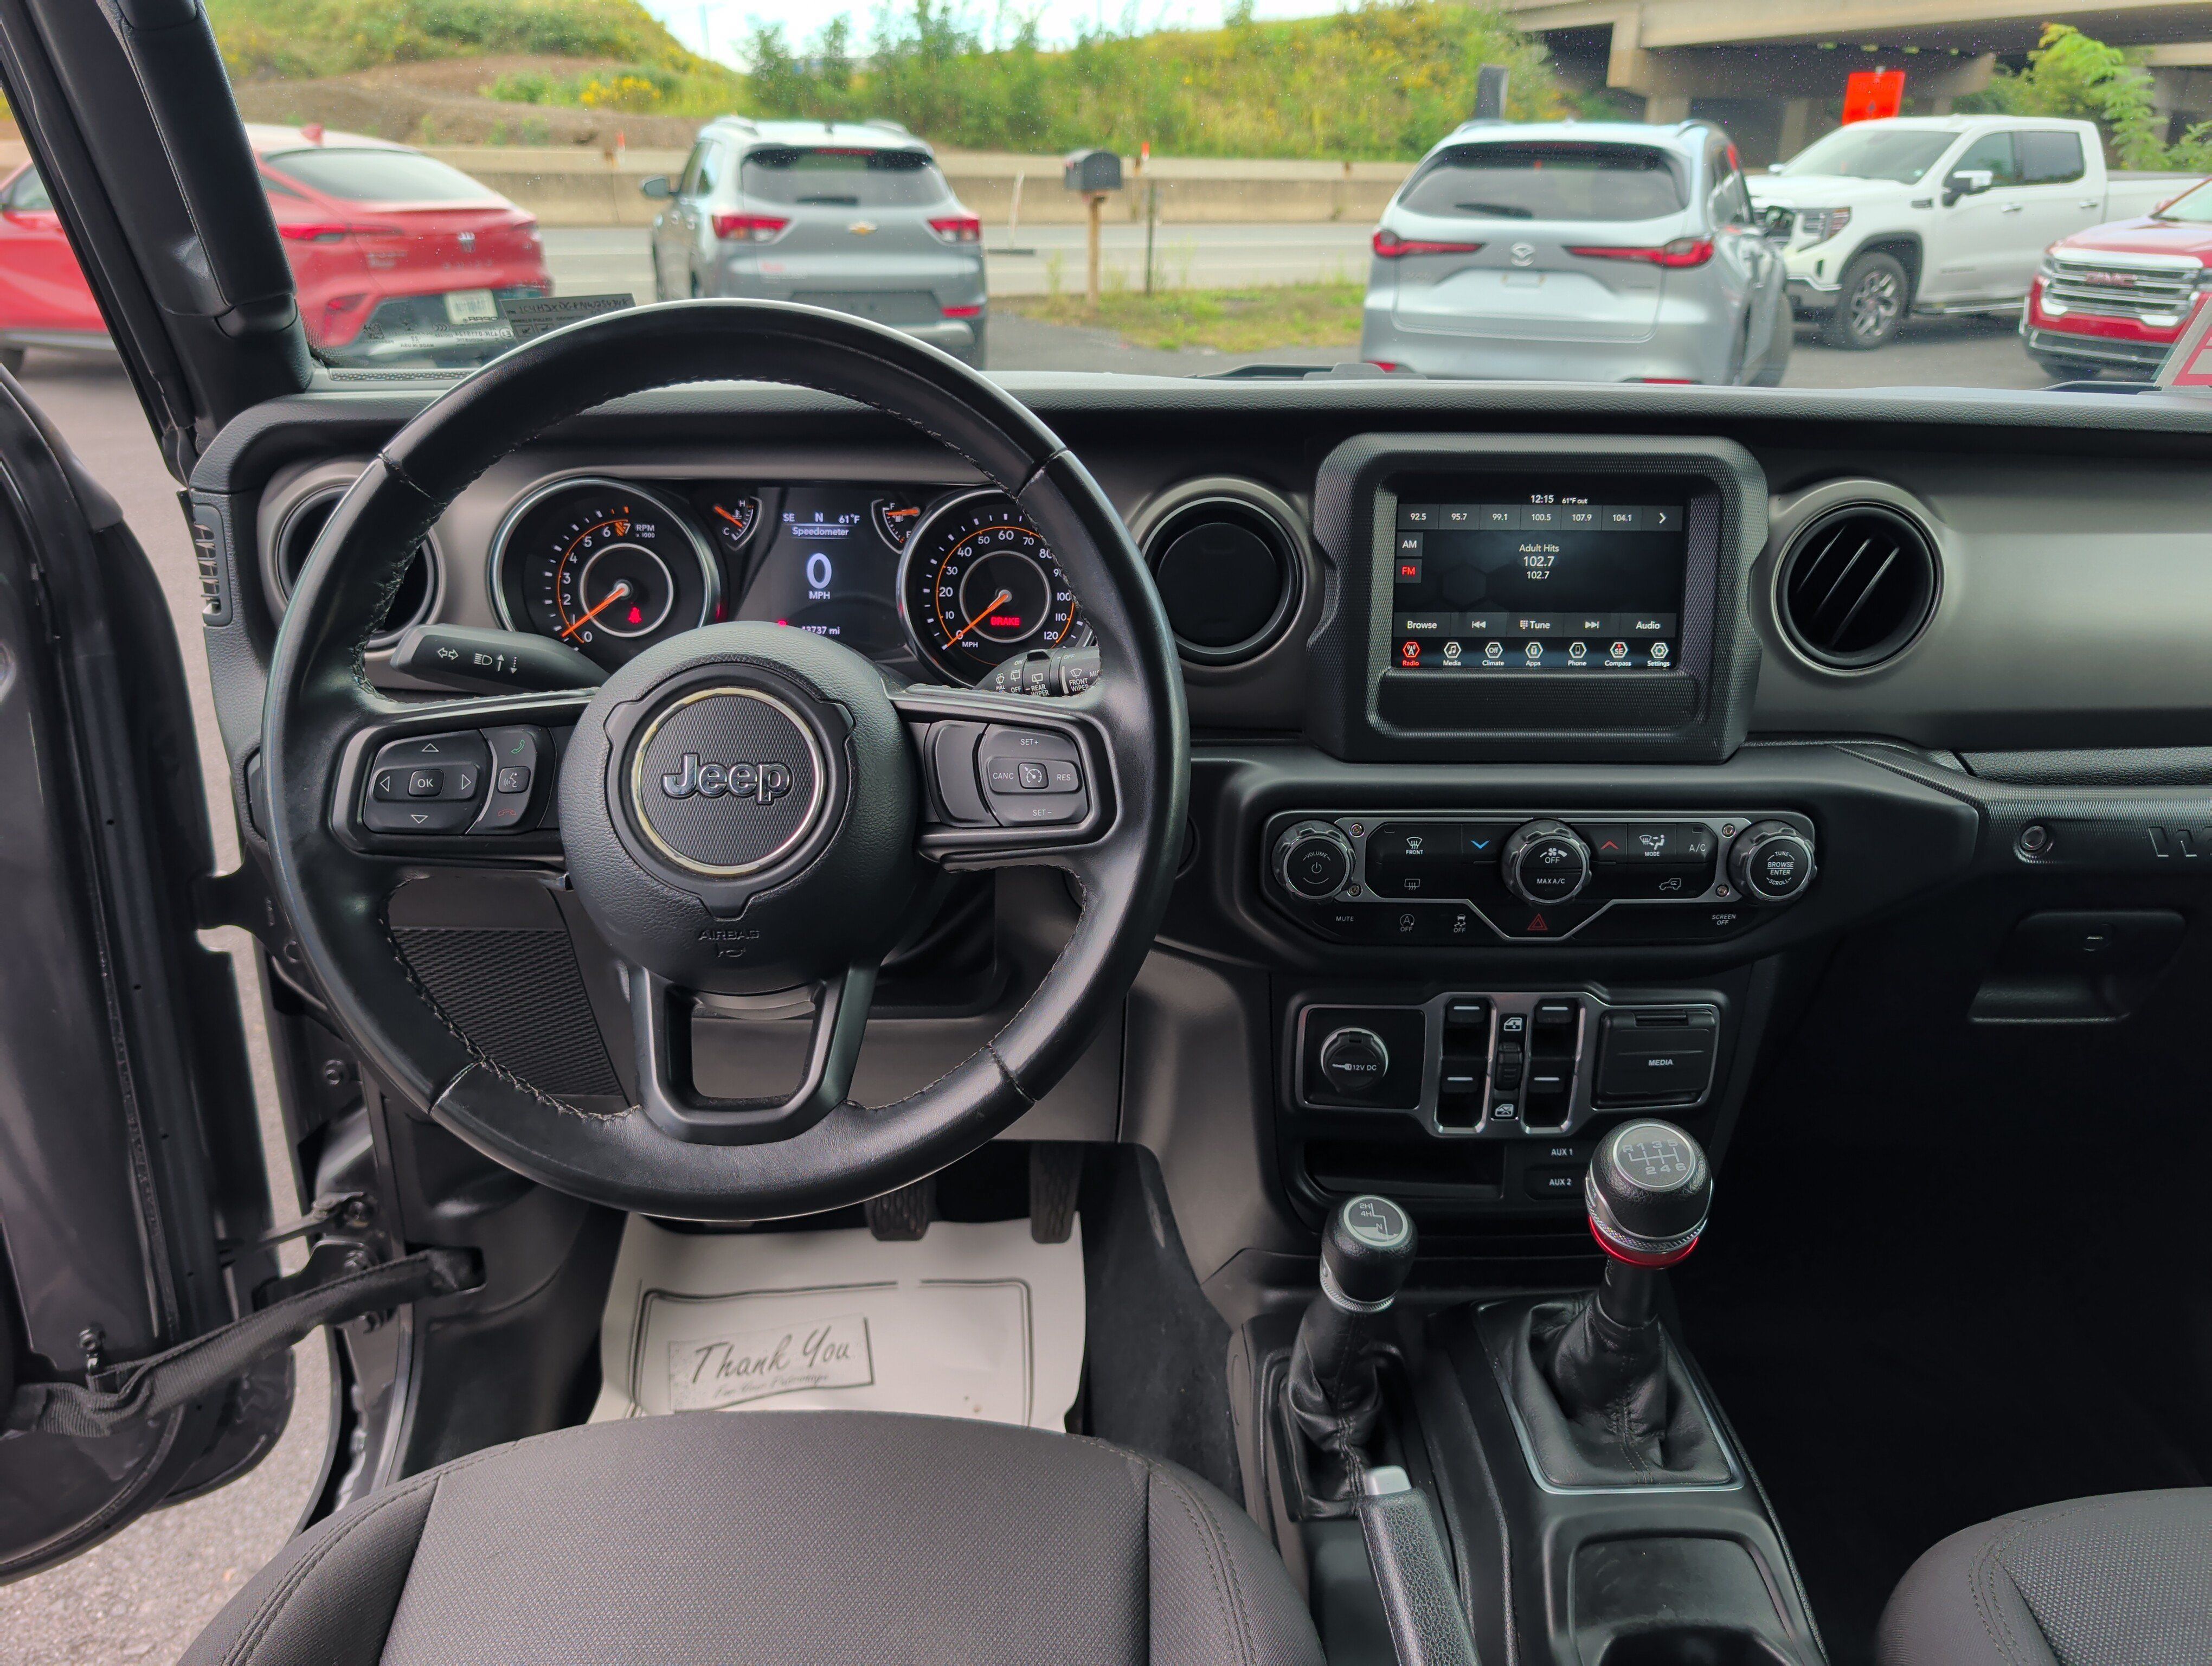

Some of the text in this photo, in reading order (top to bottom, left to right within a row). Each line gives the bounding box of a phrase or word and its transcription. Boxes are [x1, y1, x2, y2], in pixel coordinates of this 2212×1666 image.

[1531, 495, 1554, 503] 12:15
[783, 512, 795, 522] SE
[814, 512, 824, 522] N
[839, 514, 860, 524] 61°F
[1531, 513, 1552, 521] 100.5
[1572, 514, 1592, 522] 107.9
[1612, 514, 1632, 522] 104.1
[602, 527, 611, 537] 6
[623, 523, 631, 534] 7
[723, 527, 730, 535] C
[792, 527, 849, 536] Speedometer
[998, 530, 1014, 540] 60
[583, 536, 592, 547] 5
[978, 536, 990, 544] 50
[1023, 537, 1034, 545] 70
[1401, 540, 1417, 549] AM
[957, 547, 972, 557] 40
[1519, 544, 1559, 553] Adult Hits
[569, 552, 578, 563] 4
[1523, 556, 1555, 567] 102.7
[807, 553, 832, 589] 0
[946, 567, 958, 575] 30
[1401, 567, 1416, 575] FM
[1526, 571, 1549, 580] 102.7
[562, 572, 571, 584] 3
[808, 590, 831, 600] MPH
[939, 587, 953, 597] 20
[1057, 592, 1071, 601] 100
[563, 593, 571, 605] 2
[946, 611, 955, 619] 10
[1056, 613, 1067, 621] 110
[991, 617, 1020, 626] BRAKE
[1407, 620, 1437, 629] Browse
[1529, 620, 1551, 629] Tune
[1636, 621, 1661, 630] Audio
[828, 626, 841, 635] mi
[583, 631, 593, 643] 0
[1044, 631, 1059, 640] 120
[1069, 678, 1088, 686] FRONT
[1070, 684, 1089, 692] WIPER
[417, 778, 434, 787] OK
[663, 753, 793, 805] Jeep
[1689, 843, 1706, 853] A/C
[698, 931, 761, 941] AIRBAG
[1622, 1144, 1634, 1153] R
[1636, 1142, 1645, 1150] 1
[1651, 1140, 1663, 1149] 3
[1551, 1148, 1573, 1156] AUX 1
[1645, 1163, 1687, 1175] 2 4 6
[1549, 1178, 1572, 1187] AUX 2
[693, 1325, 850, 1383] Thank You
